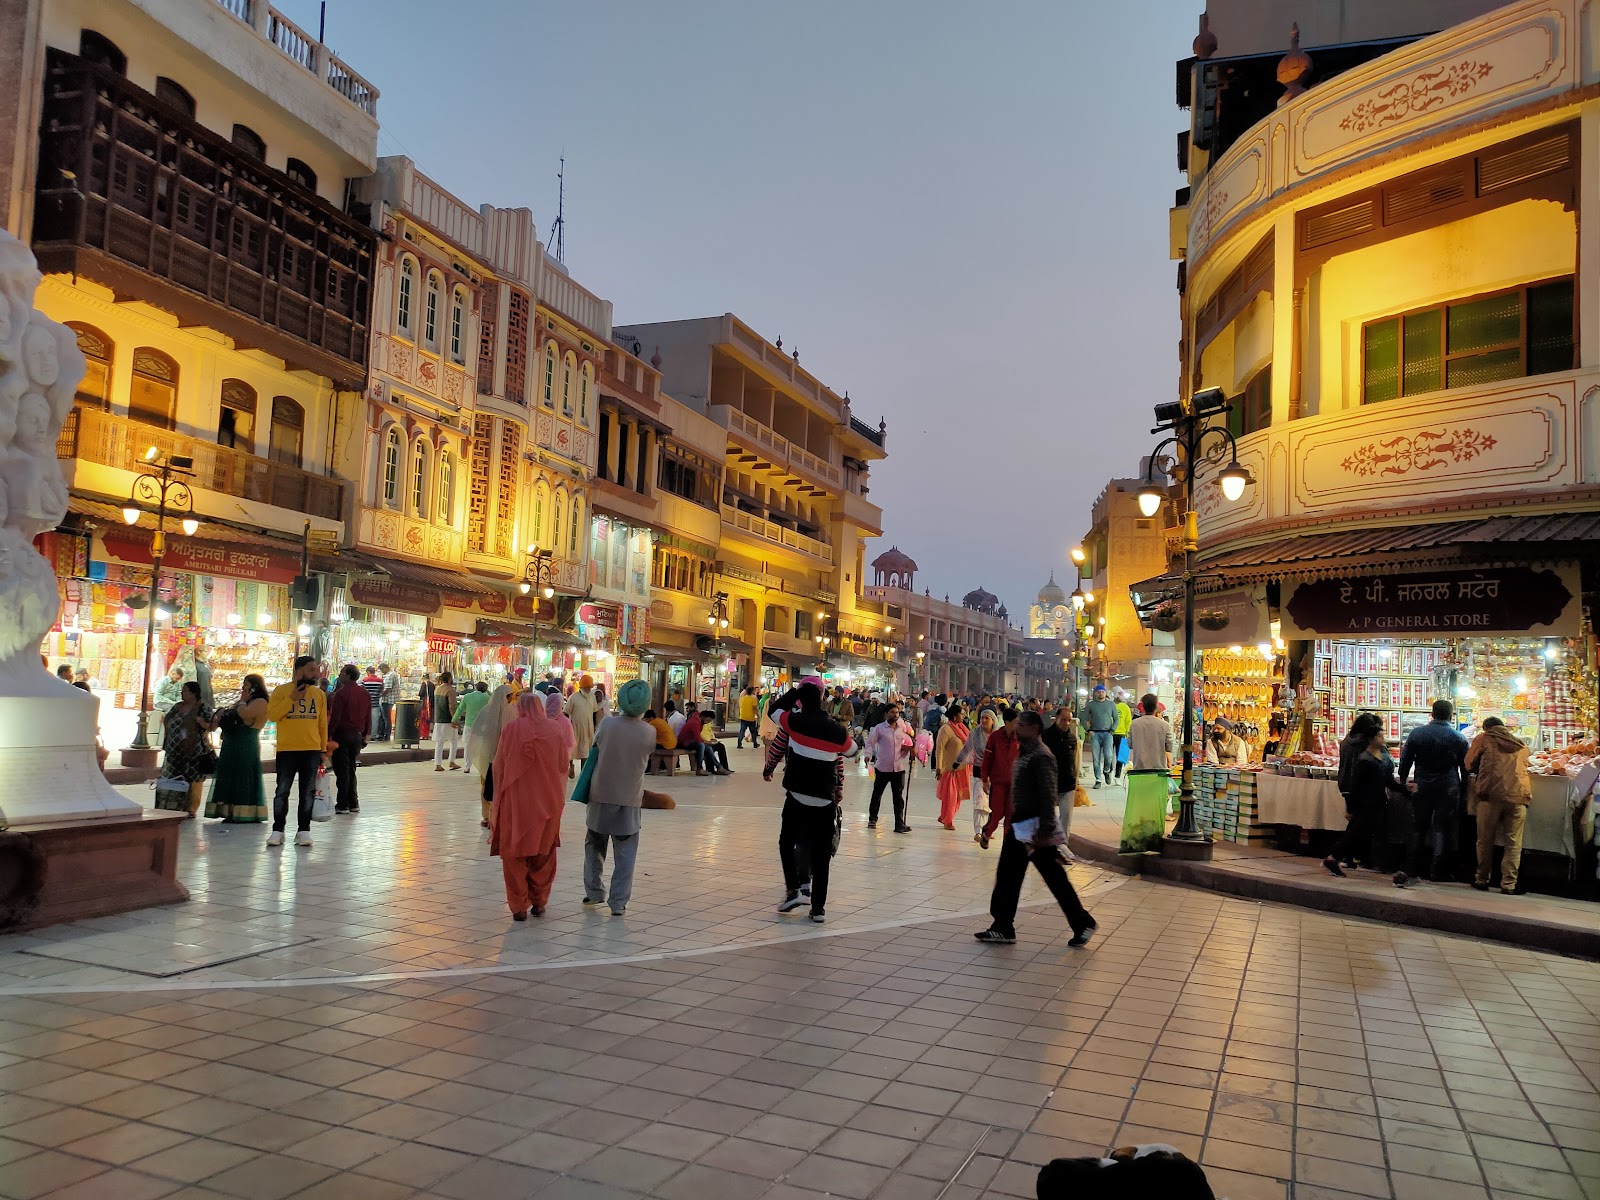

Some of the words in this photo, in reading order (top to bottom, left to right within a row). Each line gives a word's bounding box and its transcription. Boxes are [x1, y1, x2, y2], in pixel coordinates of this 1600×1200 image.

[184, 560, 222, 572] AMRITSARI
[224, 566, 257, 577] PHULKARI
[1397, 582, 1451, 602] ਜਨਰਲ
[1458, 572, 1501, 599] ਸਟੋਰ
[1347, 617, 1360, 629] A.
[1363, 616, 1371, 628] P
[1375, 614, 1439, 628] GENERAL
[1443, 613, 1491, 627] STORE
